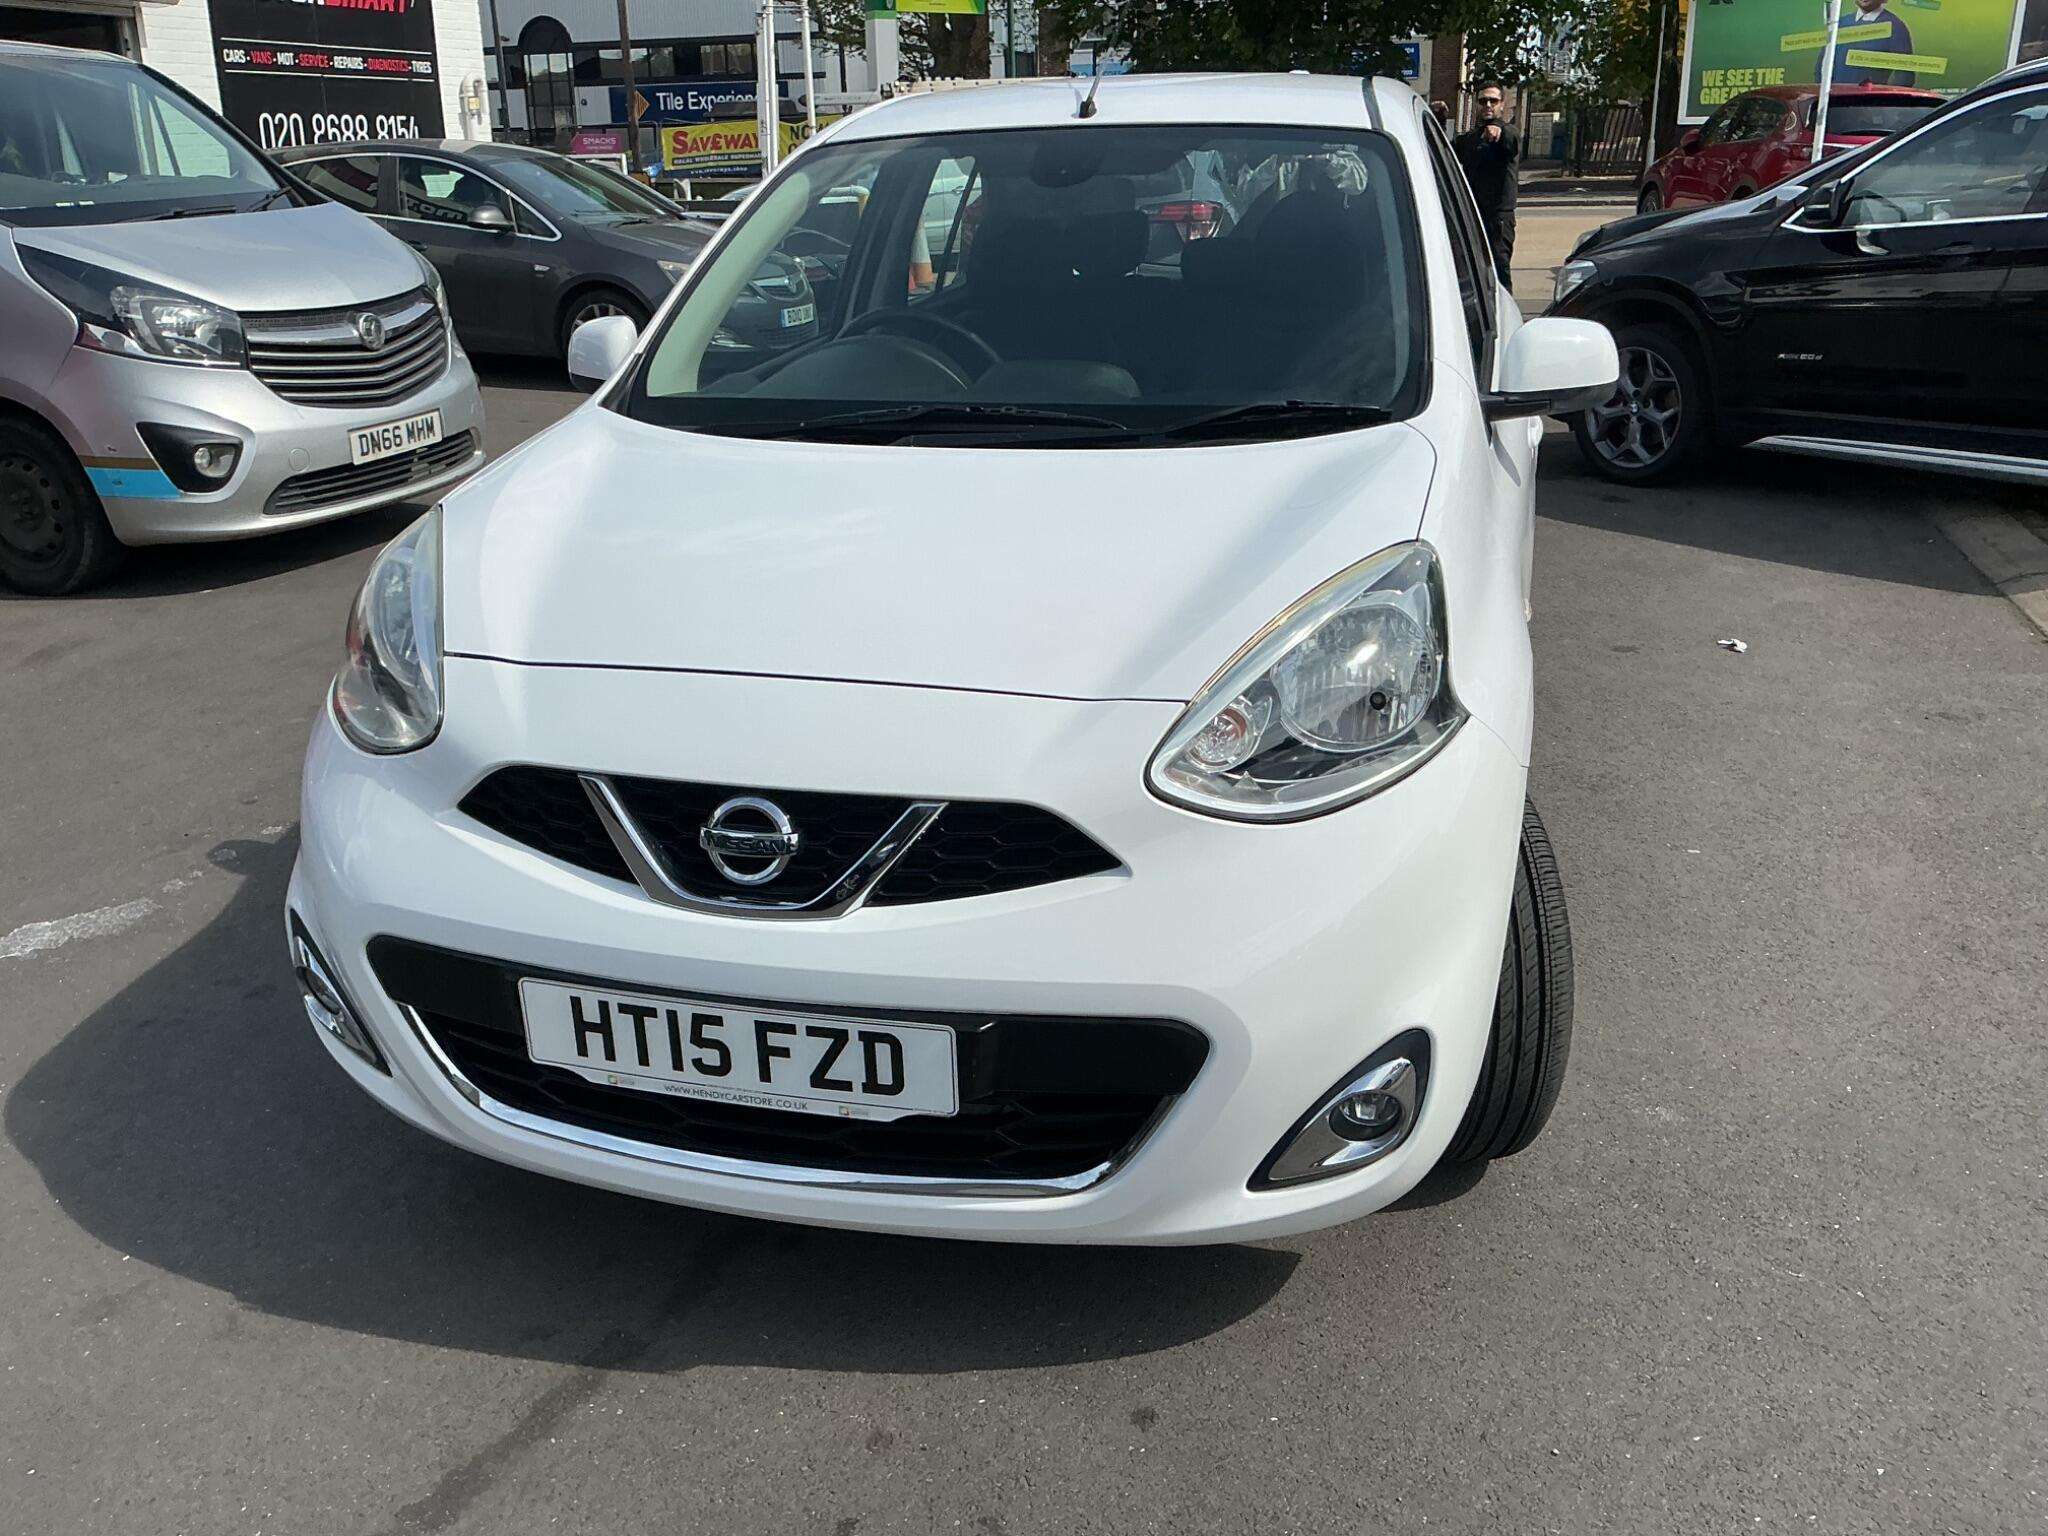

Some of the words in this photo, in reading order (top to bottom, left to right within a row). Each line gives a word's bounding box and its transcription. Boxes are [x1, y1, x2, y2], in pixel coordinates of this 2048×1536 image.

[223, 49, 246, 63] CARS
[250, 51, 273, 65] VANS
[277, 52, 294, 66] MOT
[299, 53, 330, 68] SERVICE
[333, 55, 364, 70] REPAIRS
[367, 57, 410, 72] DIAGNOSTICS
[412, 60, 433, 73] TYRES
[1702, 69, 1725, 87] WE
[1726, 68, 1754, 86] SEE
[1755, 67, 1785, 85] THE
[656, 92, 684, 111] Tile
[259, 112, 305, 149] 020
[582, 136, 617, 145] SMACKS
[358, 425, 403, 457] DN66
[405, 416, 436, 444] MHM
[569, 994, 732, 1078] HT15
[753, 1018, 906, 1097] FZD
